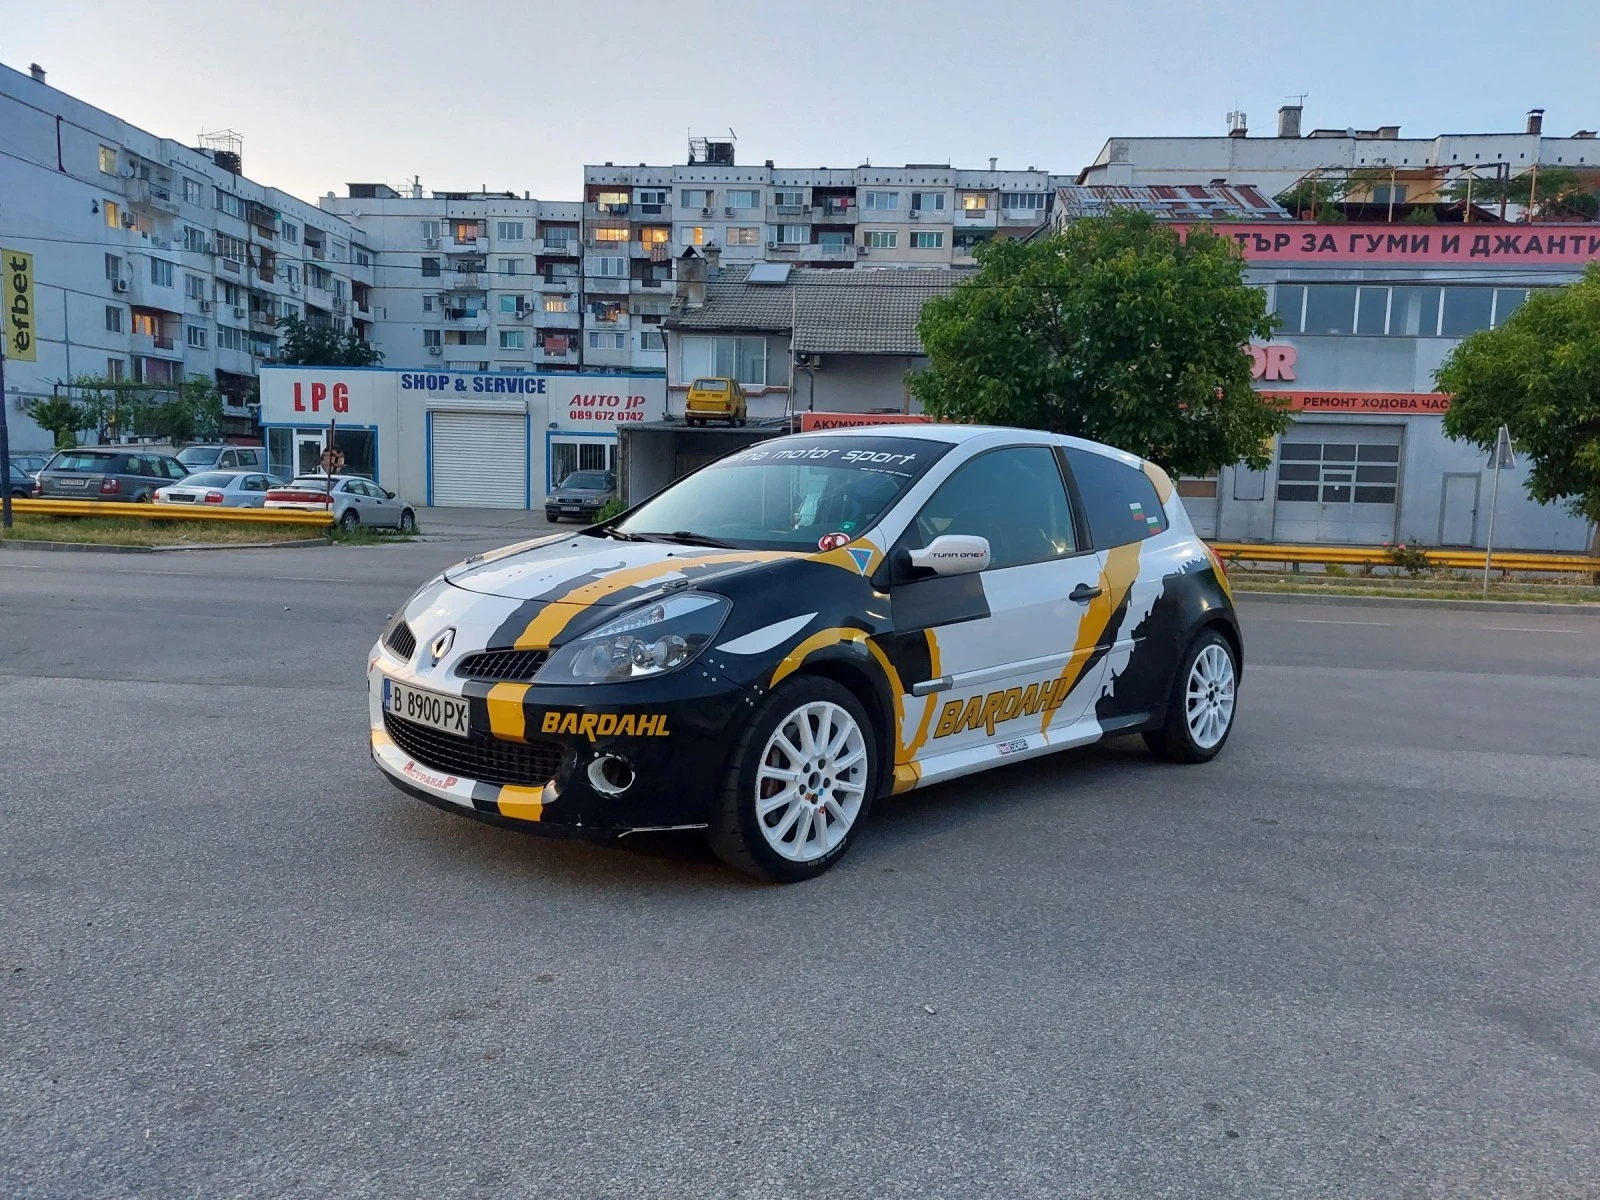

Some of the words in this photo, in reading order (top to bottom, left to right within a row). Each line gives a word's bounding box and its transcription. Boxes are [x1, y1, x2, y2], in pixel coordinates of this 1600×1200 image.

[1300, 233, 1338, 253] ЗА
[1349, 233, 1430, 254] ГУМИ
[1441, 234, 1461, 254] И
[401, 374, 450, 391] SHOP
[454, 378, 468, 392] &
[472, 376, 546, 394] SERVICE
[293, 382, 349, 413] LPG
[568, 394, 620, 407] AUTO
[624, 396, 646, 410] JP
[1303, 397, 1358, 408] РЕМОНТ
[1361, 398, 1418, 410] ХОДОВА
[1421, 398, 1449, 409] ЧАС
[569, 411, 592, 420] 089
[594, 411, 615, 421] 672
[617, 411, 644, 422] 0742
[770, 446, 840, 460] motor
[840, 449, 916, 465] sport
[394, 686, 402, 713] B
[407, 691, 442, 725] 8900
[443, 700, 467, 732] PX
[933, 676, 1068, 740] BARDAHL
[541, 711, 670, 743] BARDAHL
